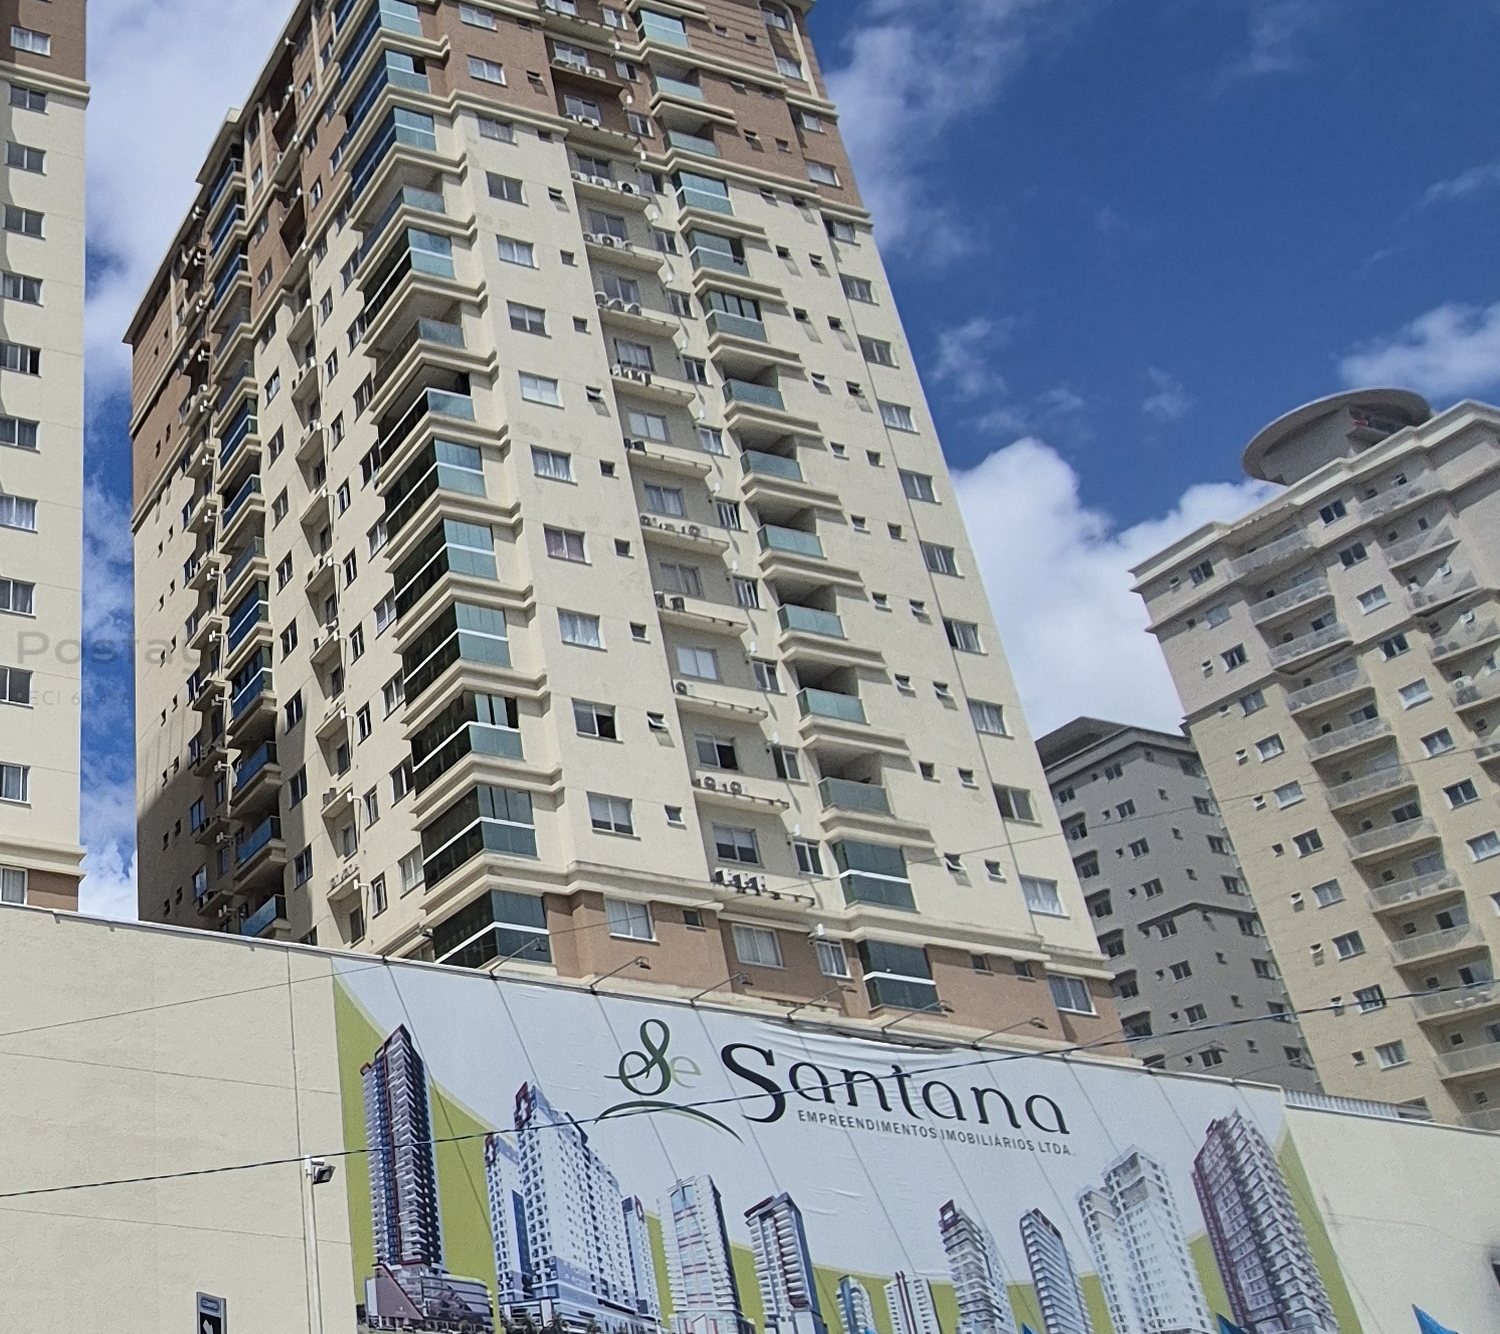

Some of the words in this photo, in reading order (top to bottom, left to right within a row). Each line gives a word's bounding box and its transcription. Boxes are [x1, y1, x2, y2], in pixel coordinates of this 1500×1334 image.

[720, 1043, 1070, 1135] Santana
[798, 1110, 937, 1140] EMPREENDIMENTOS
[941, 1128, 1034, 1152] IMOBILIÁRIOS
